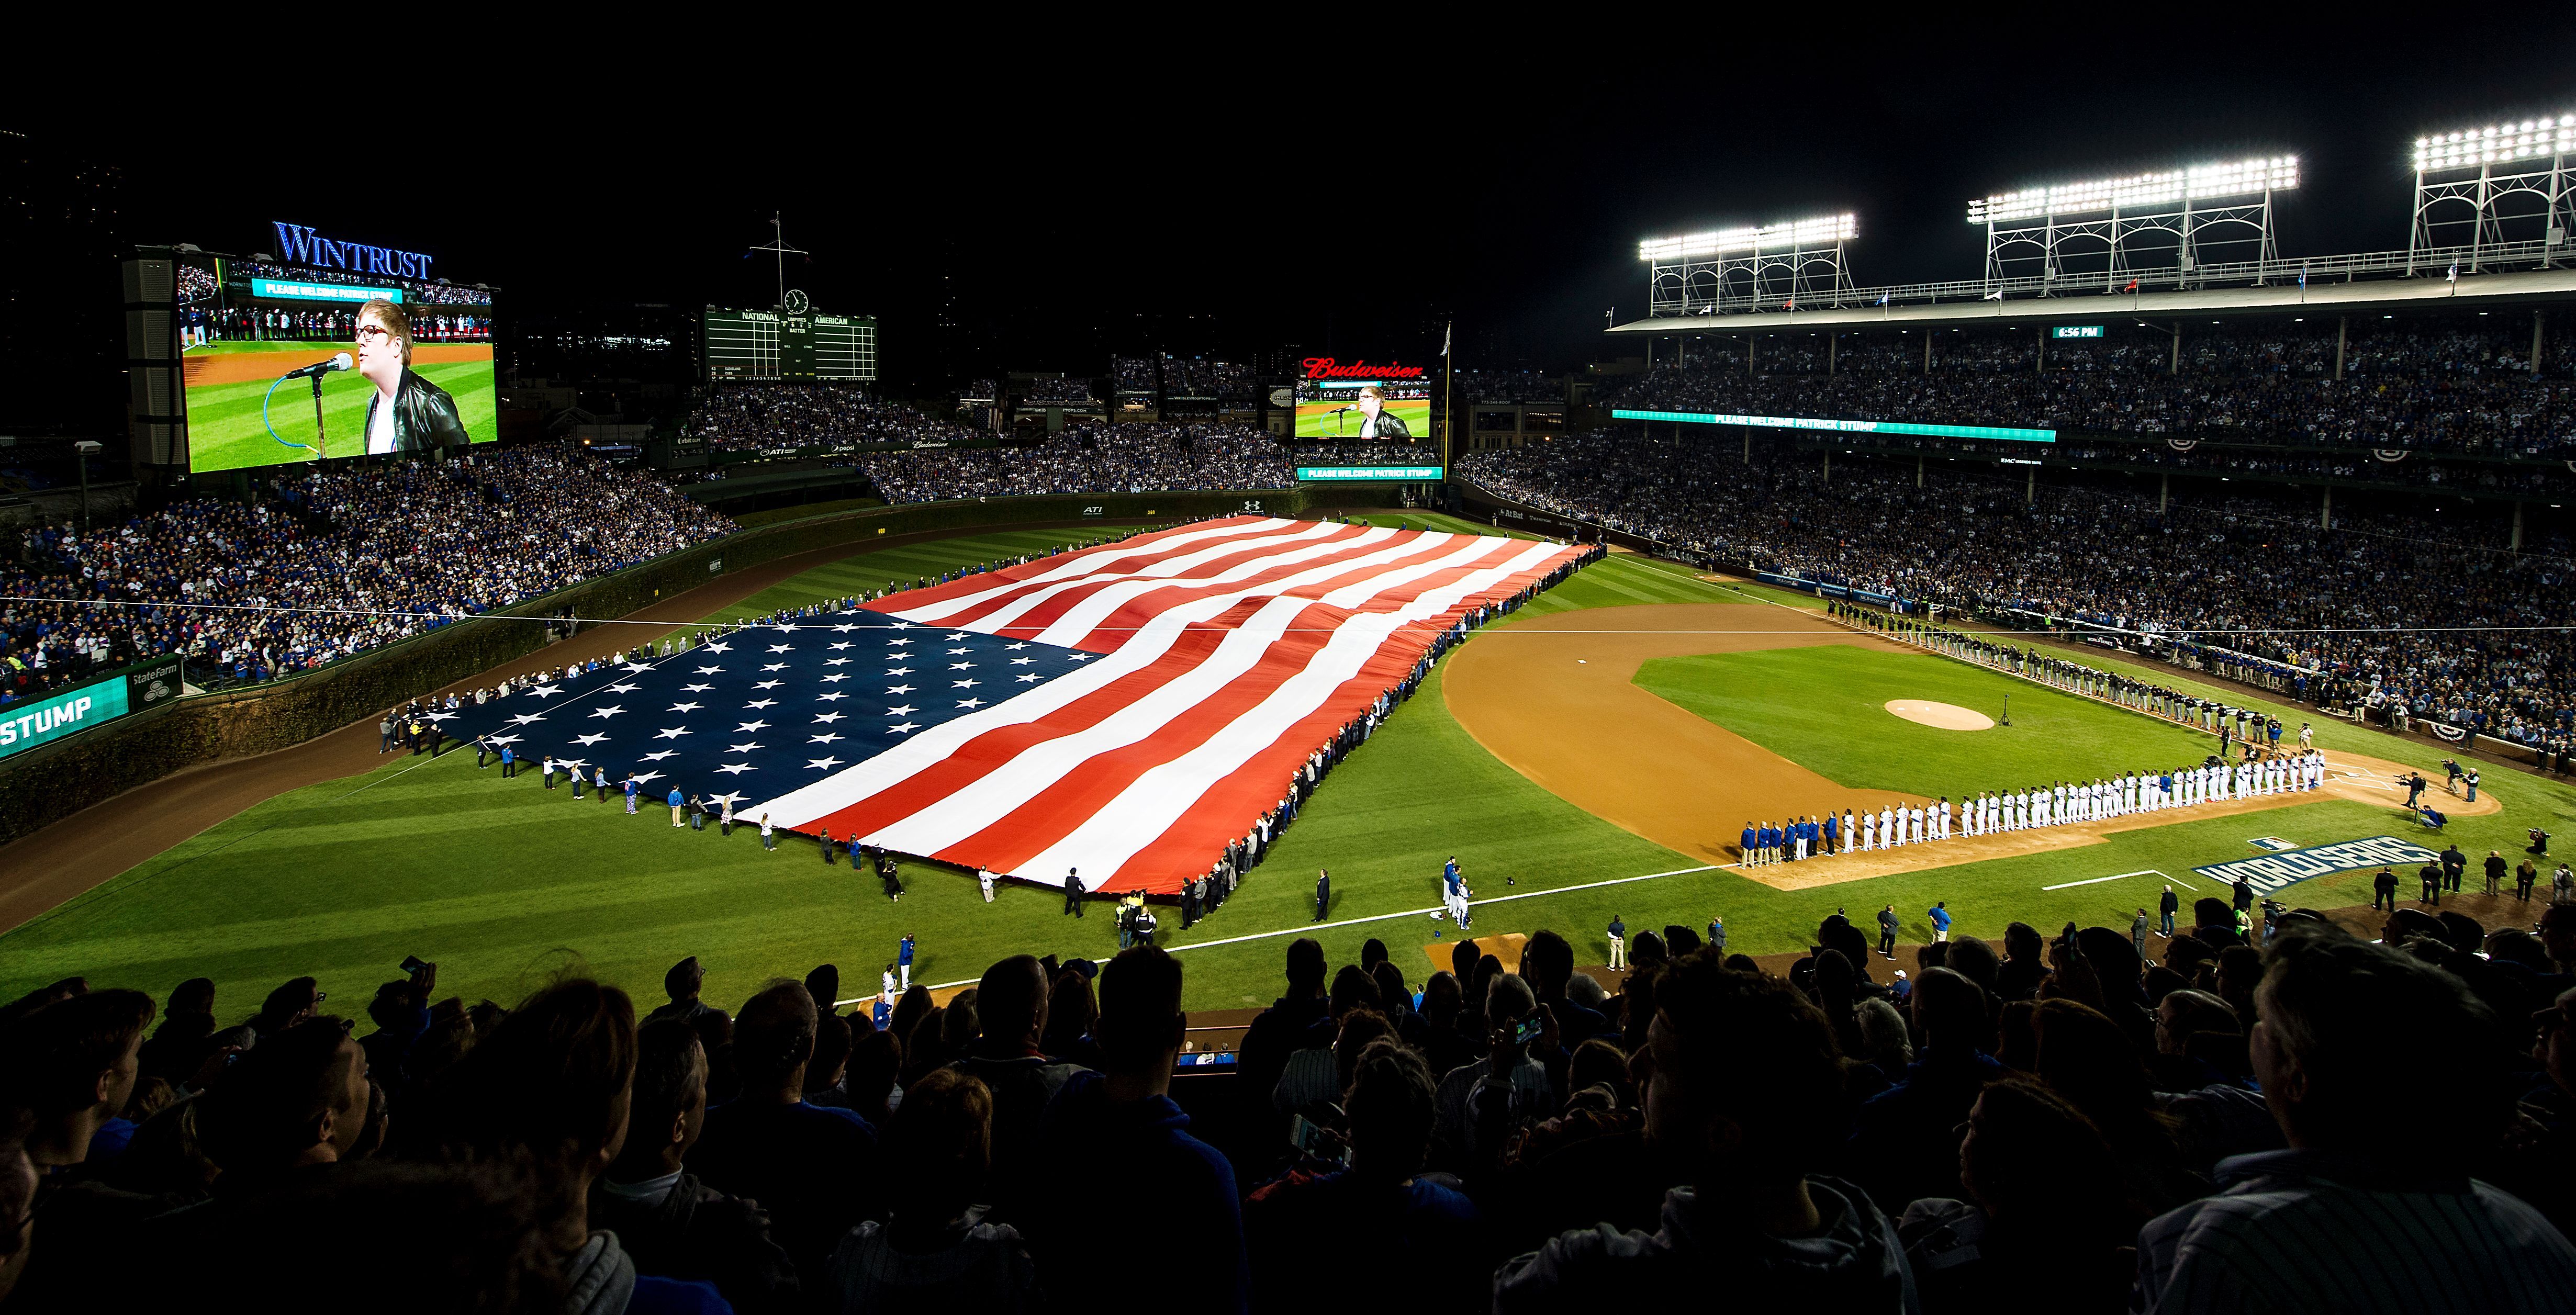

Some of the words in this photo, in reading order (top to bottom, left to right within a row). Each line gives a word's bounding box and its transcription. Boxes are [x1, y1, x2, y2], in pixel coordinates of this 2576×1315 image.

[273, 221, 432, 279] WINTRUST
[266, 284, 300, 296] PLEASE
[300, 286, 339, 298] WELCOME
[340, 289, 369, 299] PATRICK
[742, 312, 779, 321] NATIONAL
[815, 317, 847, 325] AMERICAN
[2058, 328, 2079, 337] 6:56
[2081, 327, 2098, 336] PM
[1303, 357, 1423, 379] Budweiser
[1716, 414, 1748, 425] PLEASE
[1749, 416, 1794, 427] WELCOME
[1796, 418, 1838, 430] PATRICK
[1840, 421, 1877, 432] STUMP
[1308, 469, 1337, 478] PLEASE
[1505, 509, 1513, 518] At
[1513, 510, 1524, 520] Bat
[0, 696, 92, 746] STUMP
[2196, 853, 2335, 896] WORLD
[2311, 836, 2441, 868] SERIES
